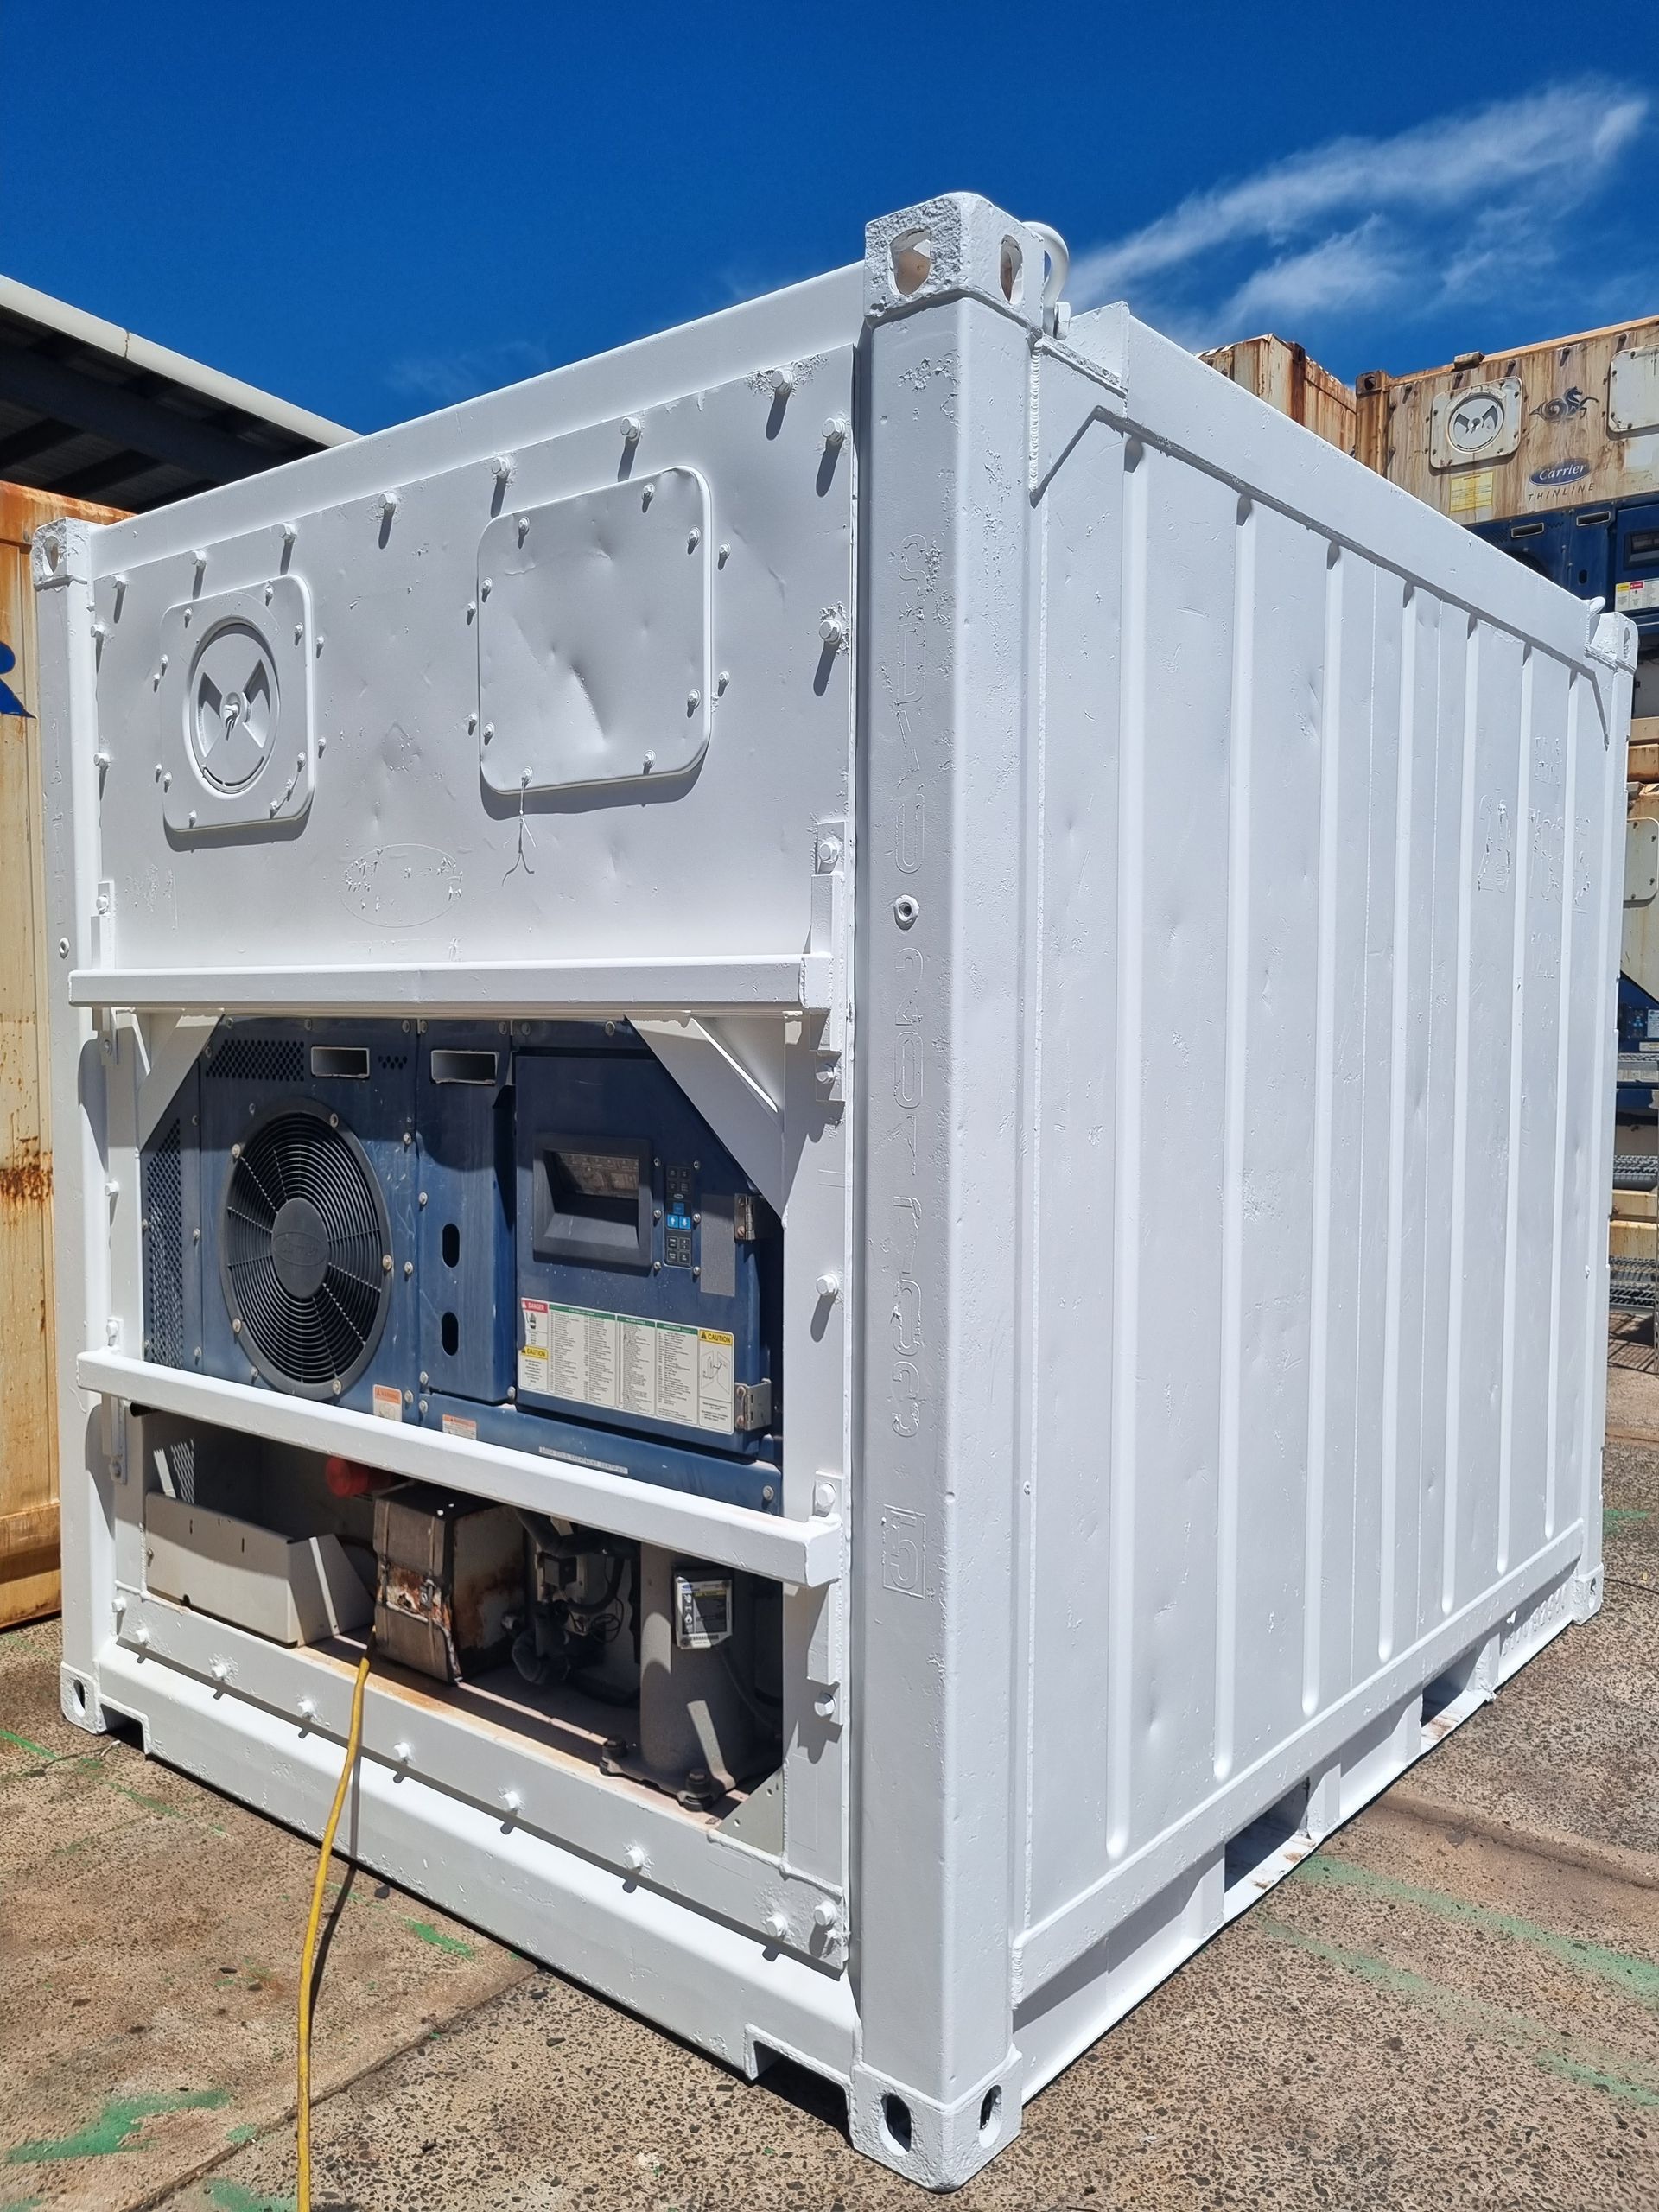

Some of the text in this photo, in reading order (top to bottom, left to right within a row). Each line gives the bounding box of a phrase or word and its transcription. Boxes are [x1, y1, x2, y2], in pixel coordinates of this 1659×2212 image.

[1539, 464, 1585, 480] Carrier
[1527, 482, 1594, 502] THINLINE
[528, 1301, 545, 1311] DANGER
[708, 1332, 732, 1344] CAUTION
[526, 1347, 546, 1357] CAUTION
